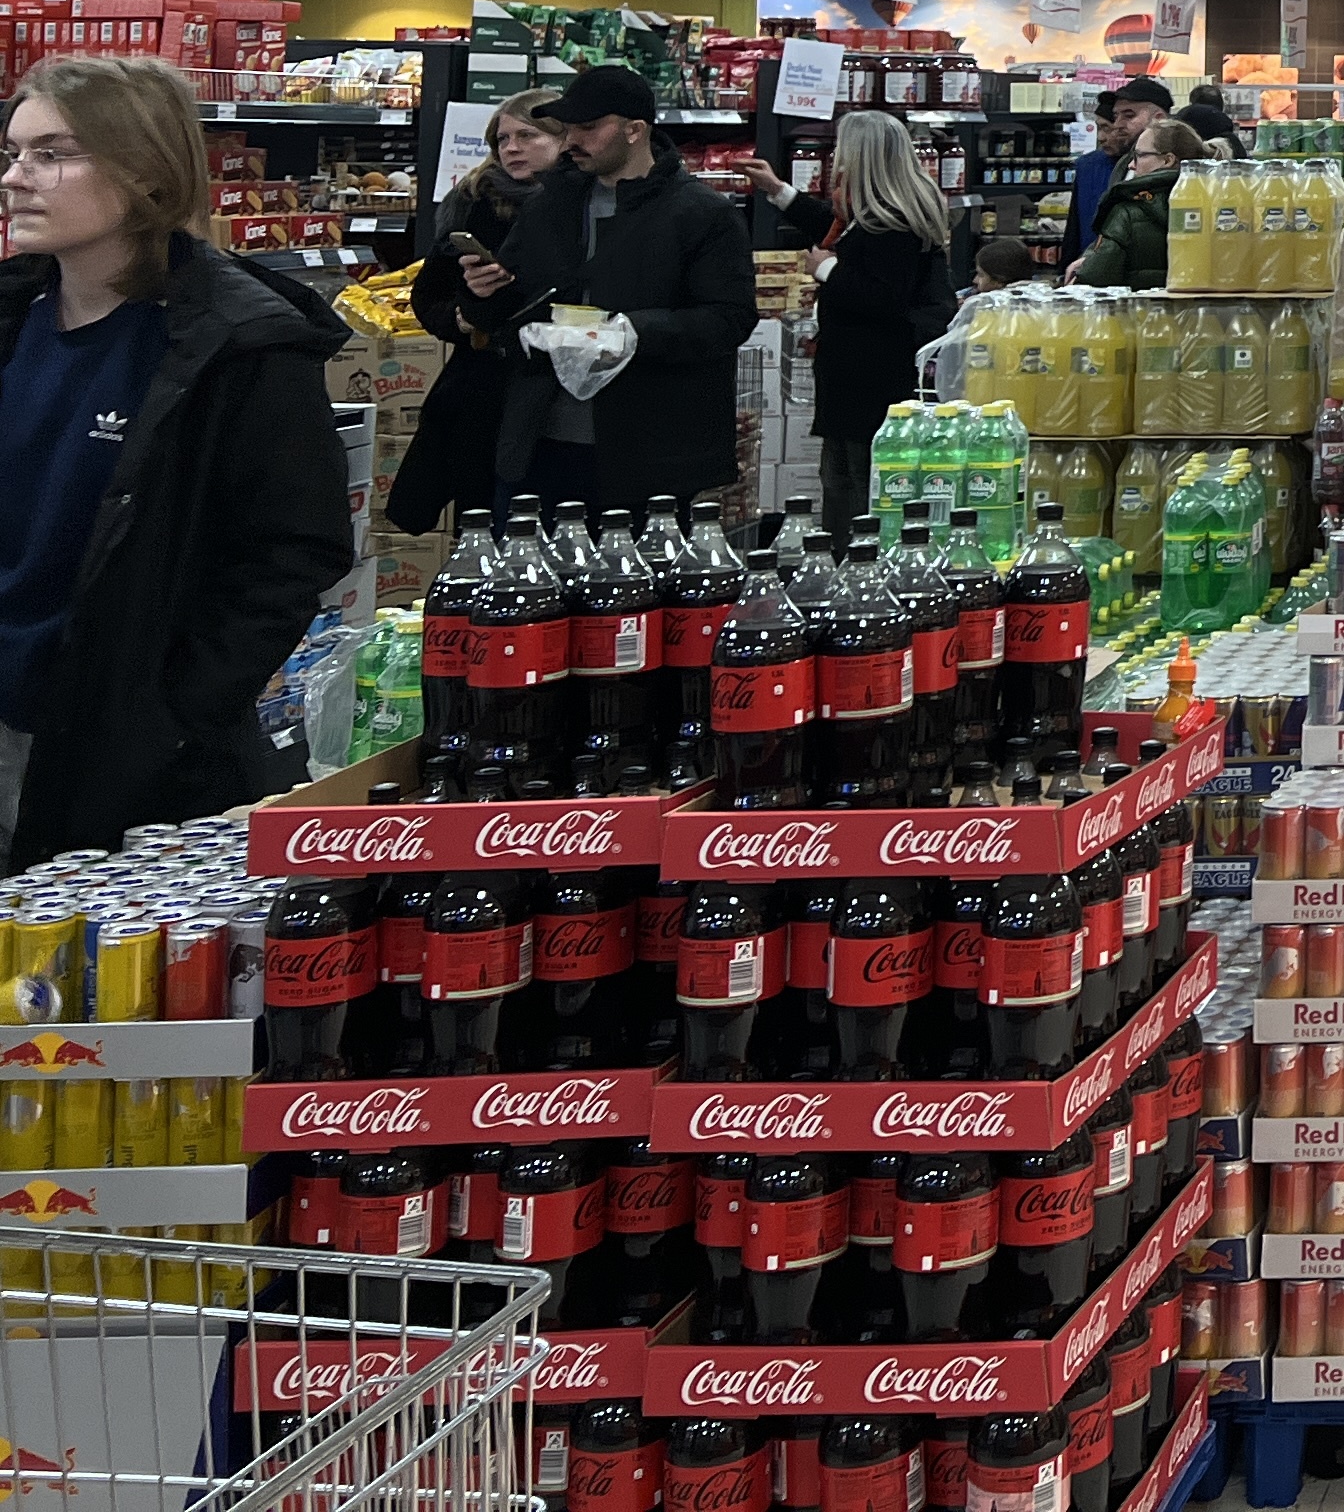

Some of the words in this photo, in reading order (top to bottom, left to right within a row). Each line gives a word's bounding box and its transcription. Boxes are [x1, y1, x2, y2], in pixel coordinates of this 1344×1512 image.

[1185, 731, 1222, 789] Coca-Cola
[1271, 765, 1295, 785] 24
[1135, 760, 1176, 821] Coca-Cola
[1199, 778, 1252, 793] AGLE
[285, 815, 434, 865] Coca-Cola
[474, 809, 623, 859] Coca-Cola
[699, 821, 840, 870] Coca-Cola
[879, 817, 1021, 866] Coca-Cola
[1077, 791, 1126, 856] Coca-Cola
[1293, 885, 1336, 906] Red
[1293, 909, 1342, 919] ENERGY
[1174, 949, 1212, 1019] Coca-Cola
[1125, 997, 1165, 1070] Coca-Cola
[1293, 1027, 1342, 1037] ENERGY
[1294, 1004, 1336, 1025] Red
[472, 1078, 619, 1129] Coca-Cola
[1063, 1048, 1116, 1127] Coca-Cola
[282, 1088, 430, 1139] Coca-Cola
[689, 1093, 833, 1141] Coca-Cola
[873, 1091, 1016, 1139] Coca-Cola
[1294, 1123, 1337, 1144] Red
[1294, 1147, 1343, 1157] ENERGY
[1172, 1176, 1209, 1248] Coca-Cola
[1122, 1229, 1163, 1312] Coca-Cola
[1301, 1240, 1344, 1261] Red
[1062, 1292, 1111, 1383] Coca-Cola
[681, 1358, 823, 1407] Coca-Cola
[863, 1355, 1008, 1403] Coca-Cola
[1168, 1392, 1204, 1478] Coca-Cola
